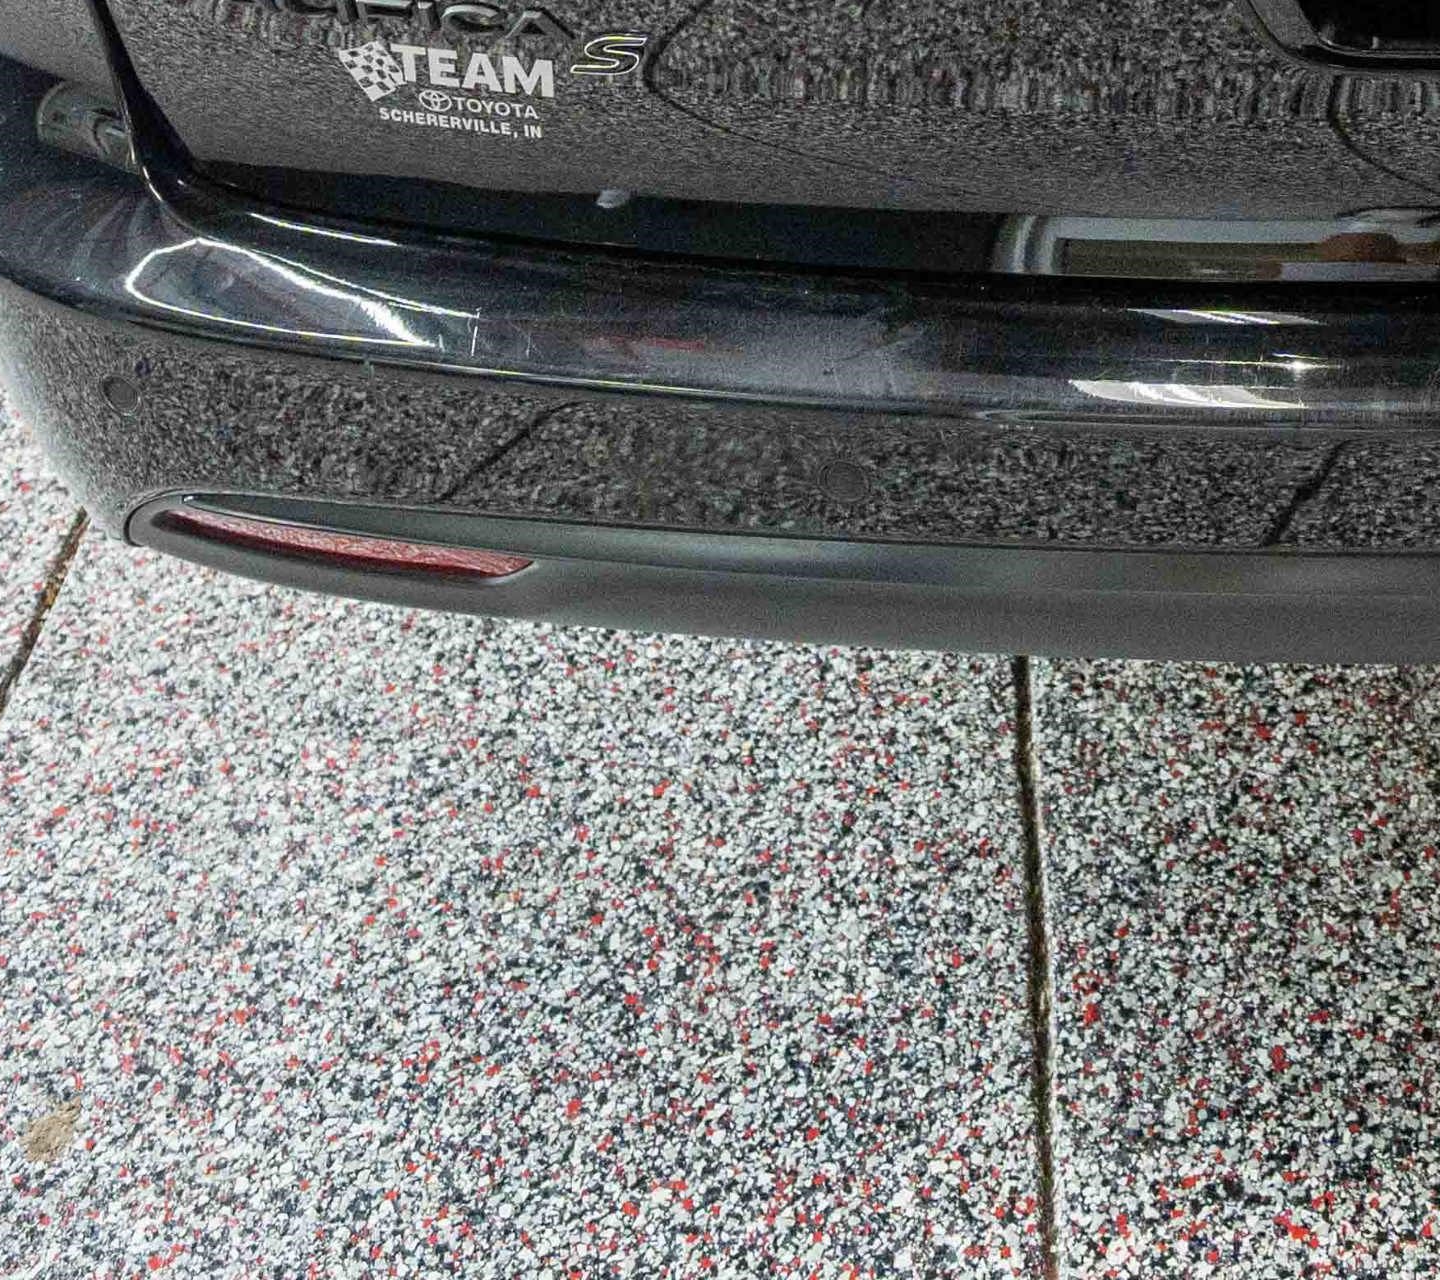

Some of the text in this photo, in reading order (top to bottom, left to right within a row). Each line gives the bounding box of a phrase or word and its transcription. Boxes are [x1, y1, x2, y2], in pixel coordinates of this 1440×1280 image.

[394, 45, 555, 99] TEAM
[570, 34, 648, 77] S
[379, 107, 543, 139] SCHERERVILLE, IN
[452, 96, 539, 120] TOYOTA
